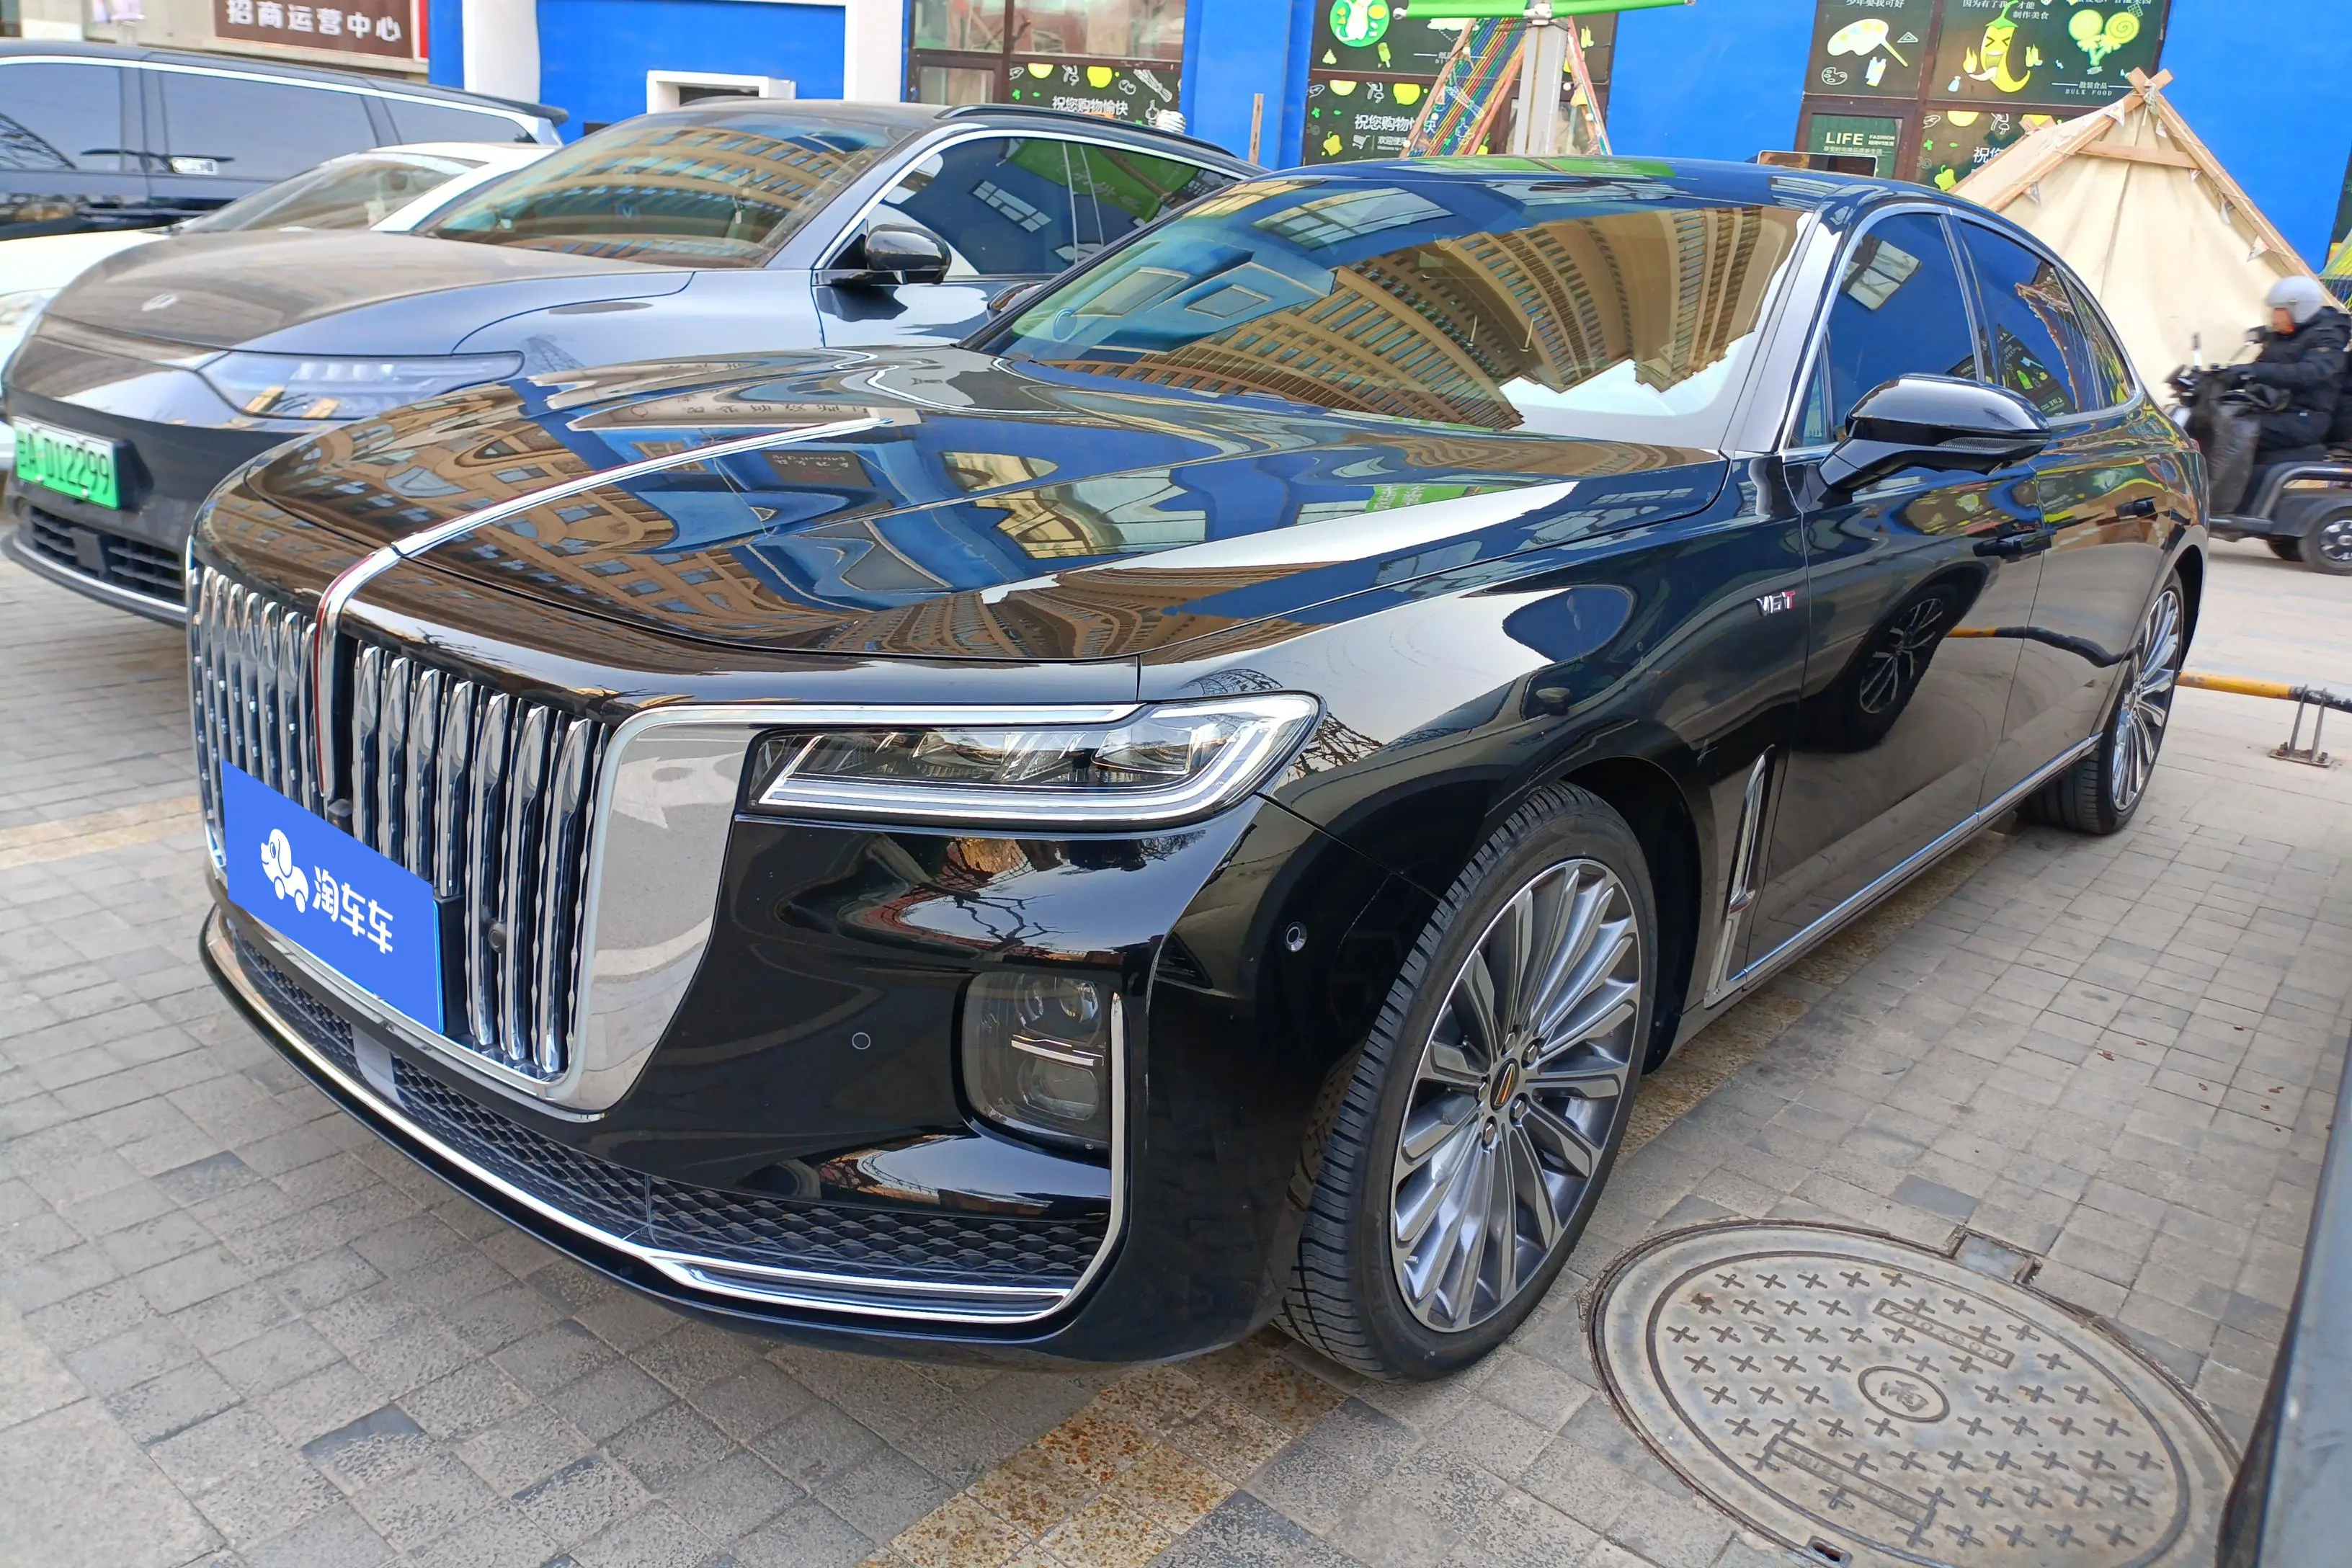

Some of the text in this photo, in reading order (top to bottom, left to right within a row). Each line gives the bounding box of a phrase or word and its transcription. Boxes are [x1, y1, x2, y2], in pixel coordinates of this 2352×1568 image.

[227, 0, 402, 42] 招商运营中心
[2013, 11, 2049, 19] 制作美食
[1052, 95, 1128, 116] 祝您购物愉快
[1825, 132, 1864, 146] LIFE
